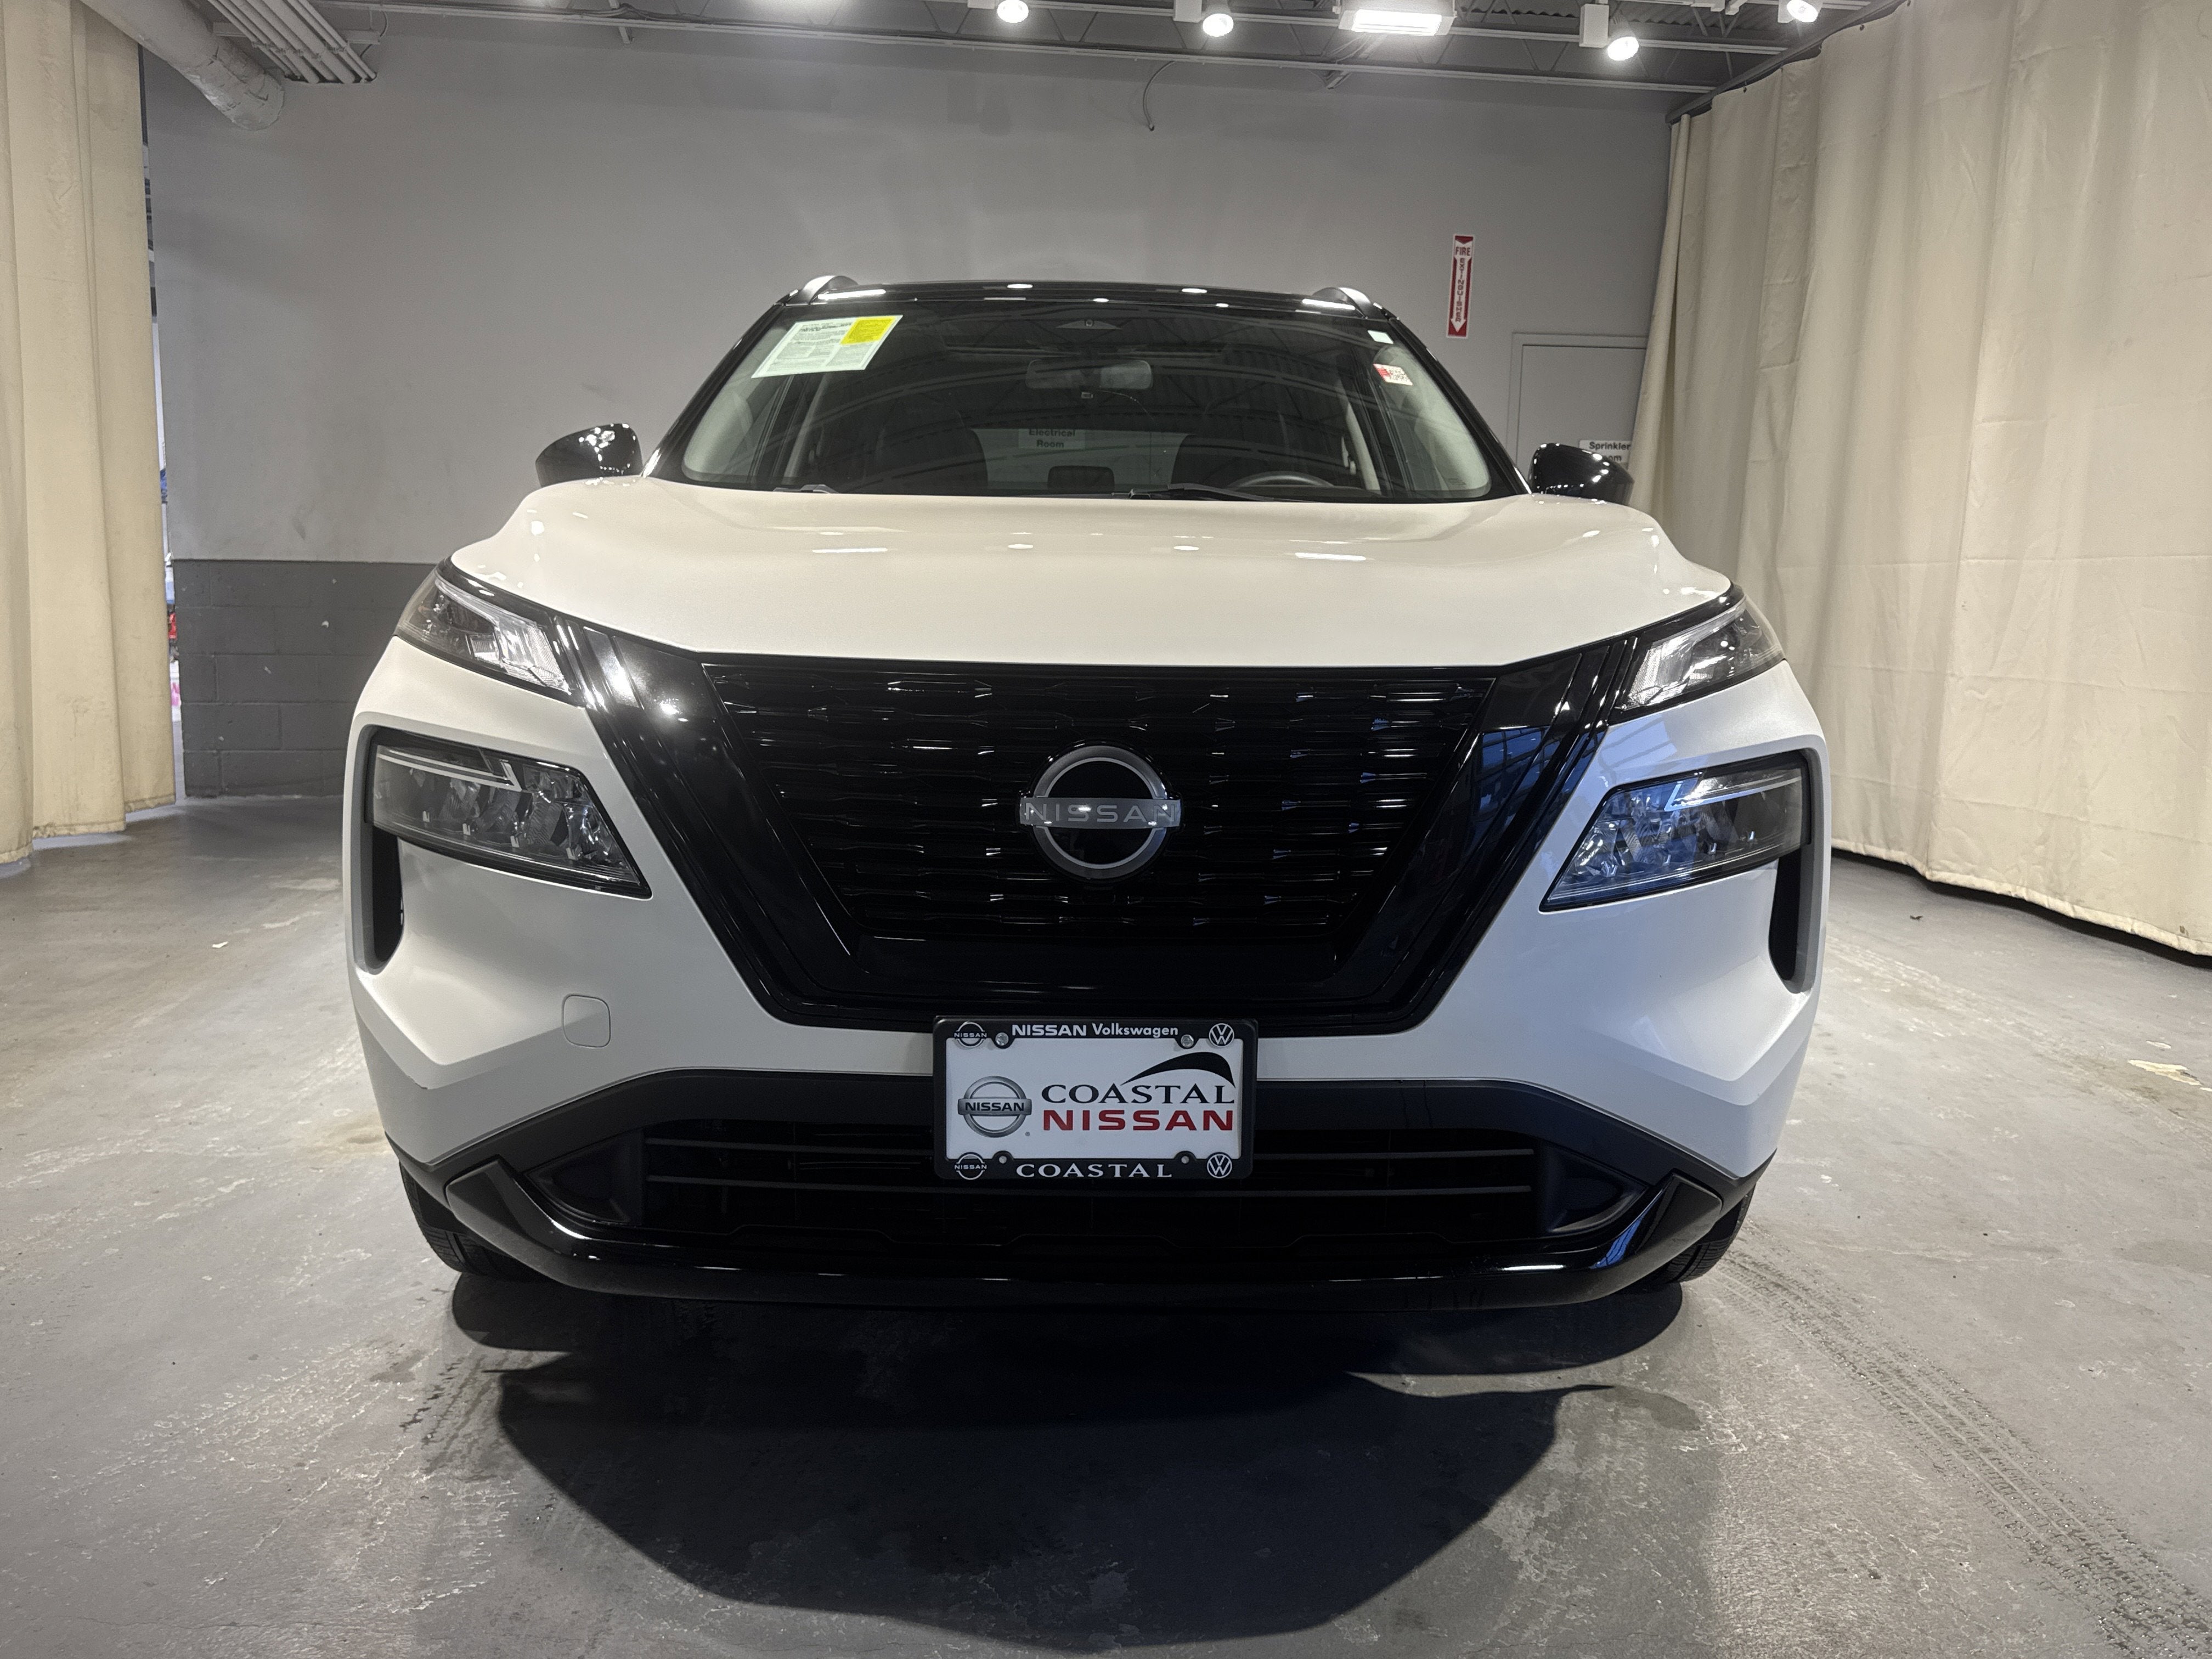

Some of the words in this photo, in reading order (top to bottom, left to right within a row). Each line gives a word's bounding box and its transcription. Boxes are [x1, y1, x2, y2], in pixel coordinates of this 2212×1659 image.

[1455, 246, 1471, 256] FIRE
[1455, 258, 1465, 323] EXTINGUISHER
[1028, 428, 1075, 437] Electrical
[1036, 439, 1064, 448] Room
[1589, 441, 1631, 450] Sprinkler
[1025, 803, 1175, 823] NISSAN
[1012, 1024, 1087, 1036] NISSAN
[1092, 1023, 1178, 1038] Volkswagen
[1041, 1082, 1234, 1104] COASTAL
[965, 1102, 1024, 1111] NISSAN
[1043, 1109, 1233, 1131] NISSAN
[1016, 1163, 1172, 1177] COASTAL
